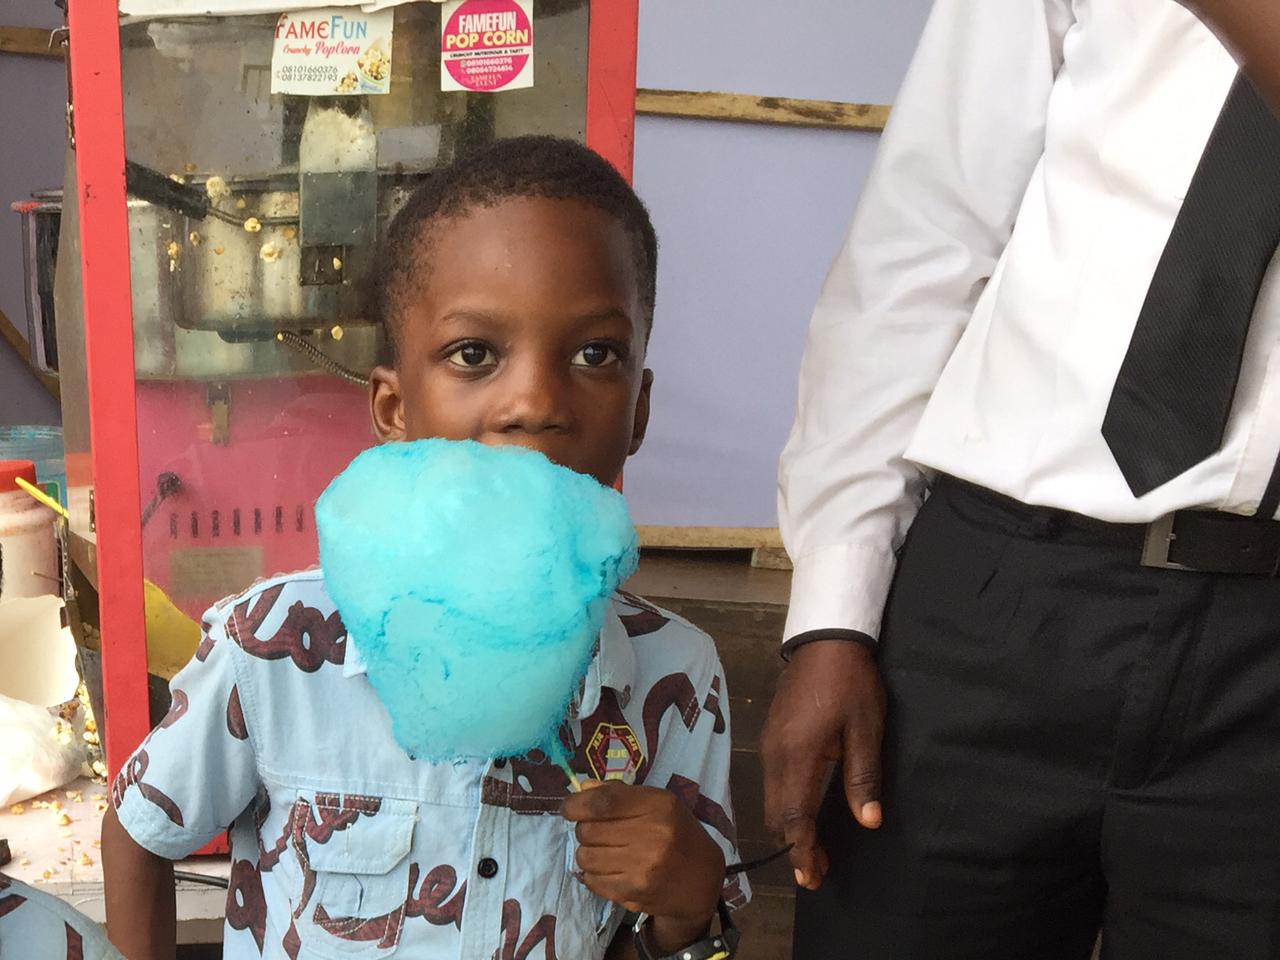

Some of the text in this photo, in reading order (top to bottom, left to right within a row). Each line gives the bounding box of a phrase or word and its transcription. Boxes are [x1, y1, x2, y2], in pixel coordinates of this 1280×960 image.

[458, 11, 517, 33] FAMEFUN
[446, 29, 529, 49] POP CORN
